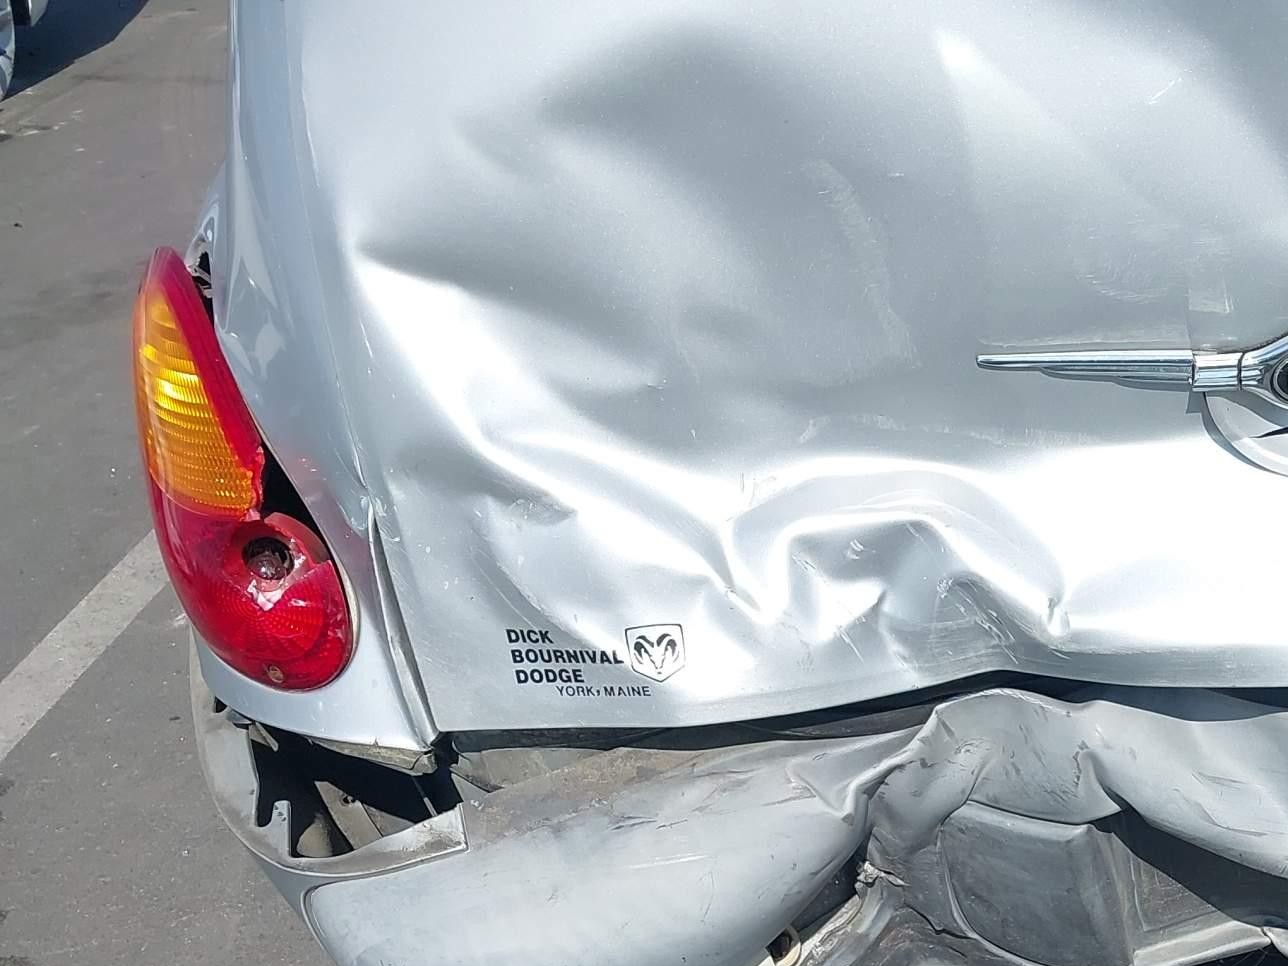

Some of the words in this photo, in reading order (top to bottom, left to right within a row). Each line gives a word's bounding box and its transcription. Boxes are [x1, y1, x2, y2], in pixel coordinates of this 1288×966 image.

[506, 628, 554, 645] DICK
[511, 648, 625, 665] BOURNIVAL
[515, 667, 585, 685] DODGE
[604, 686, 652, 698] MAINE
